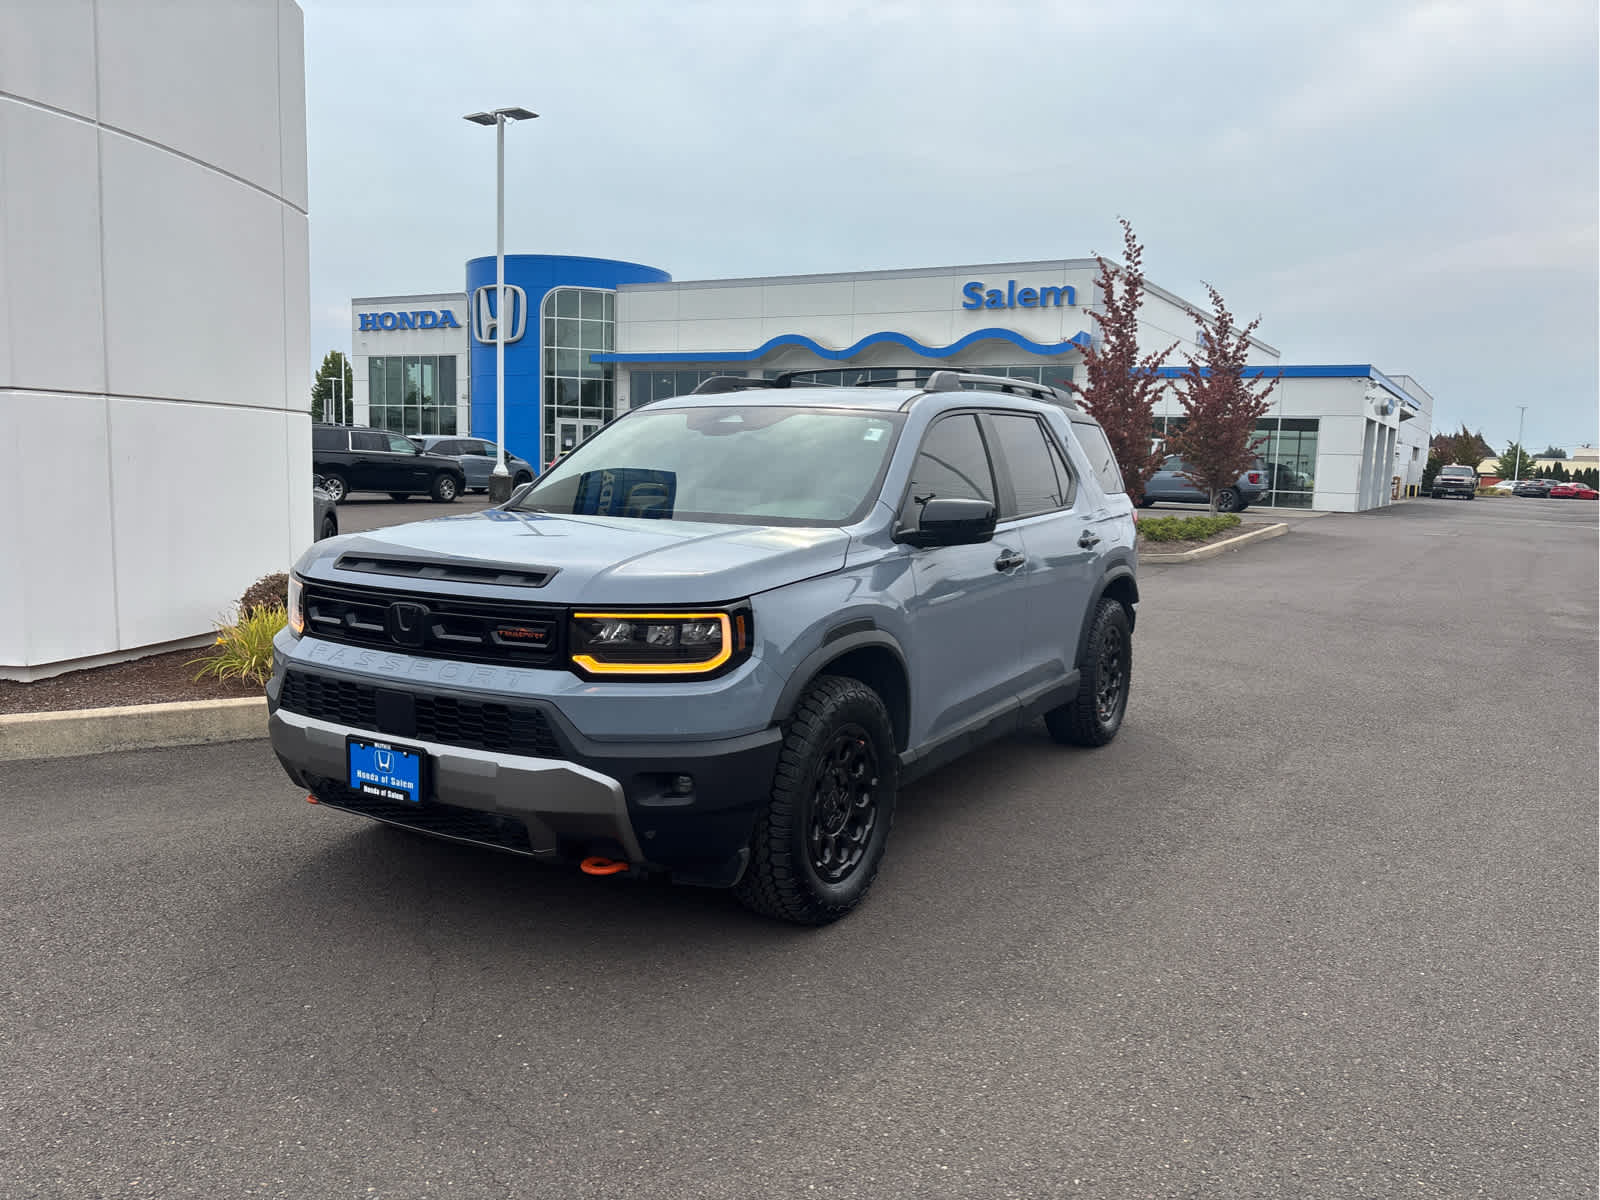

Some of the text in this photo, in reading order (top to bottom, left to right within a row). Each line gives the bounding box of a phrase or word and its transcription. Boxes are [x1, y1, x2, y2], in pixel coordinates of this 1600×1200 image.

[962, 280, 1076, 310] Salem
[358, 309, 462, 331] HONDA
[307, 642, 533, 689] PASSPORT
[356, 769, 414, 789] Honda of Salem
[363, 785, 380, 795] Honda
